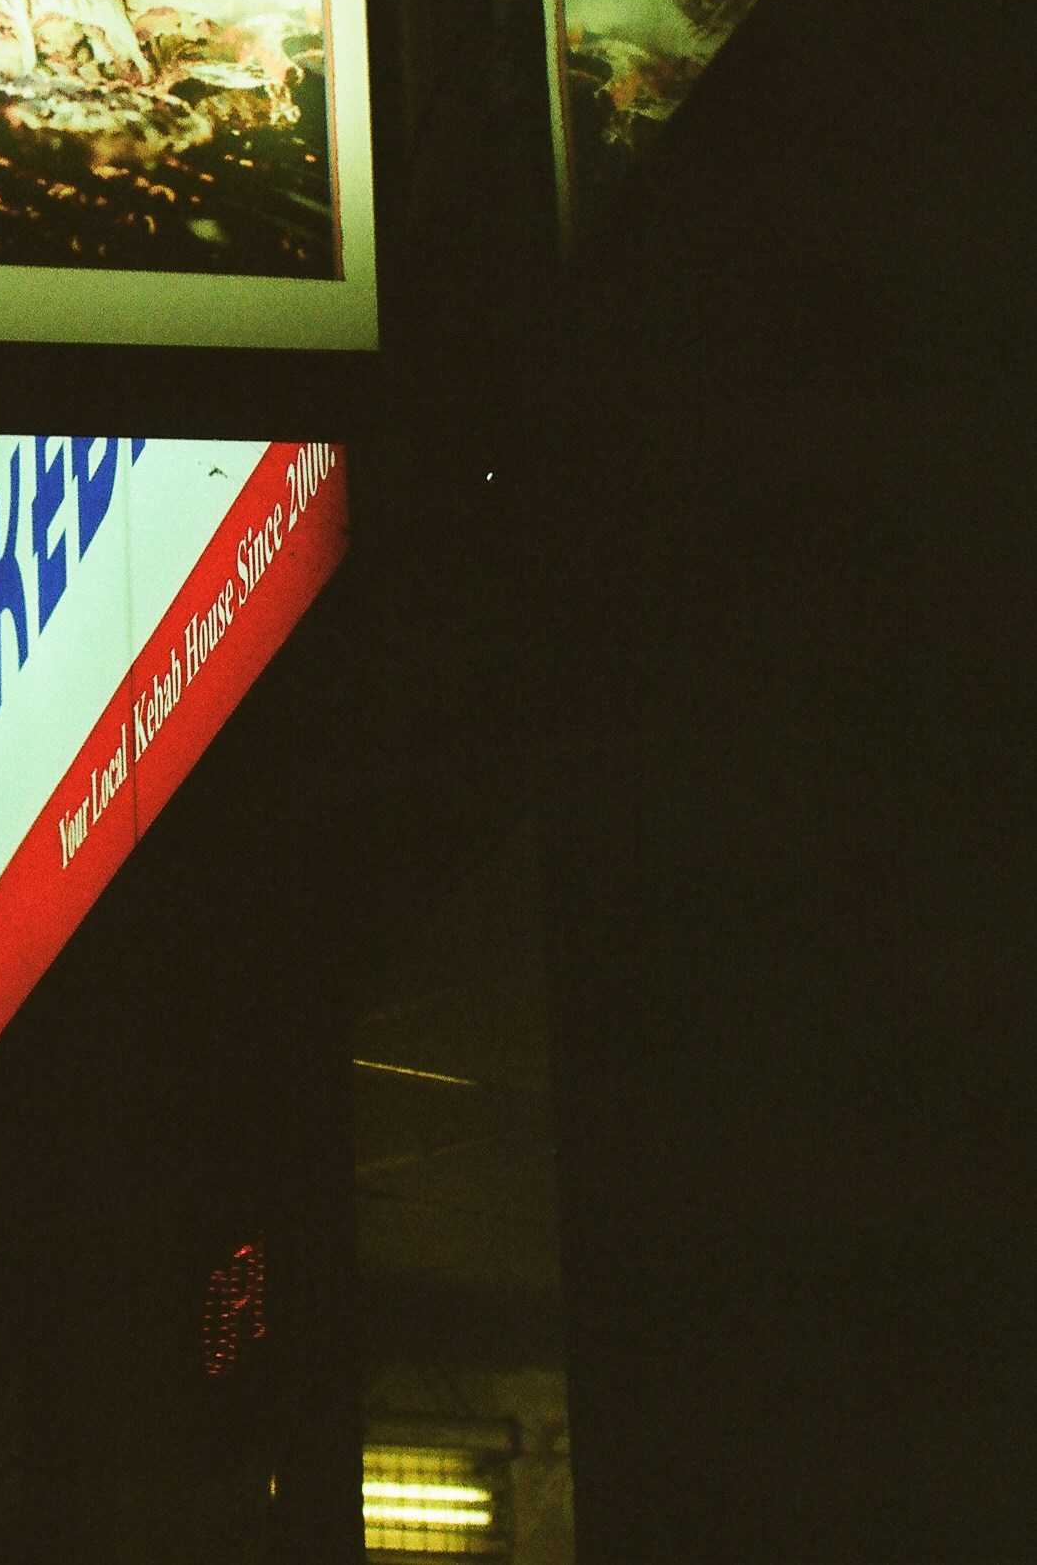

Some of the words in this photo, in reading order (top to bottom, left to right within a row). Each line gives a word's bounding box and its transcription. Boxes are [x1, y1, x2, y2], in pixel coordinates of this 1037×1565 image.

[58, 796, 90, 870] Your
[90, 722, 129, 826] Local
[132, 647, 182, 763] Kebab
[184, 578, 235, 687] House
[236, 501, 283, 608] Since
